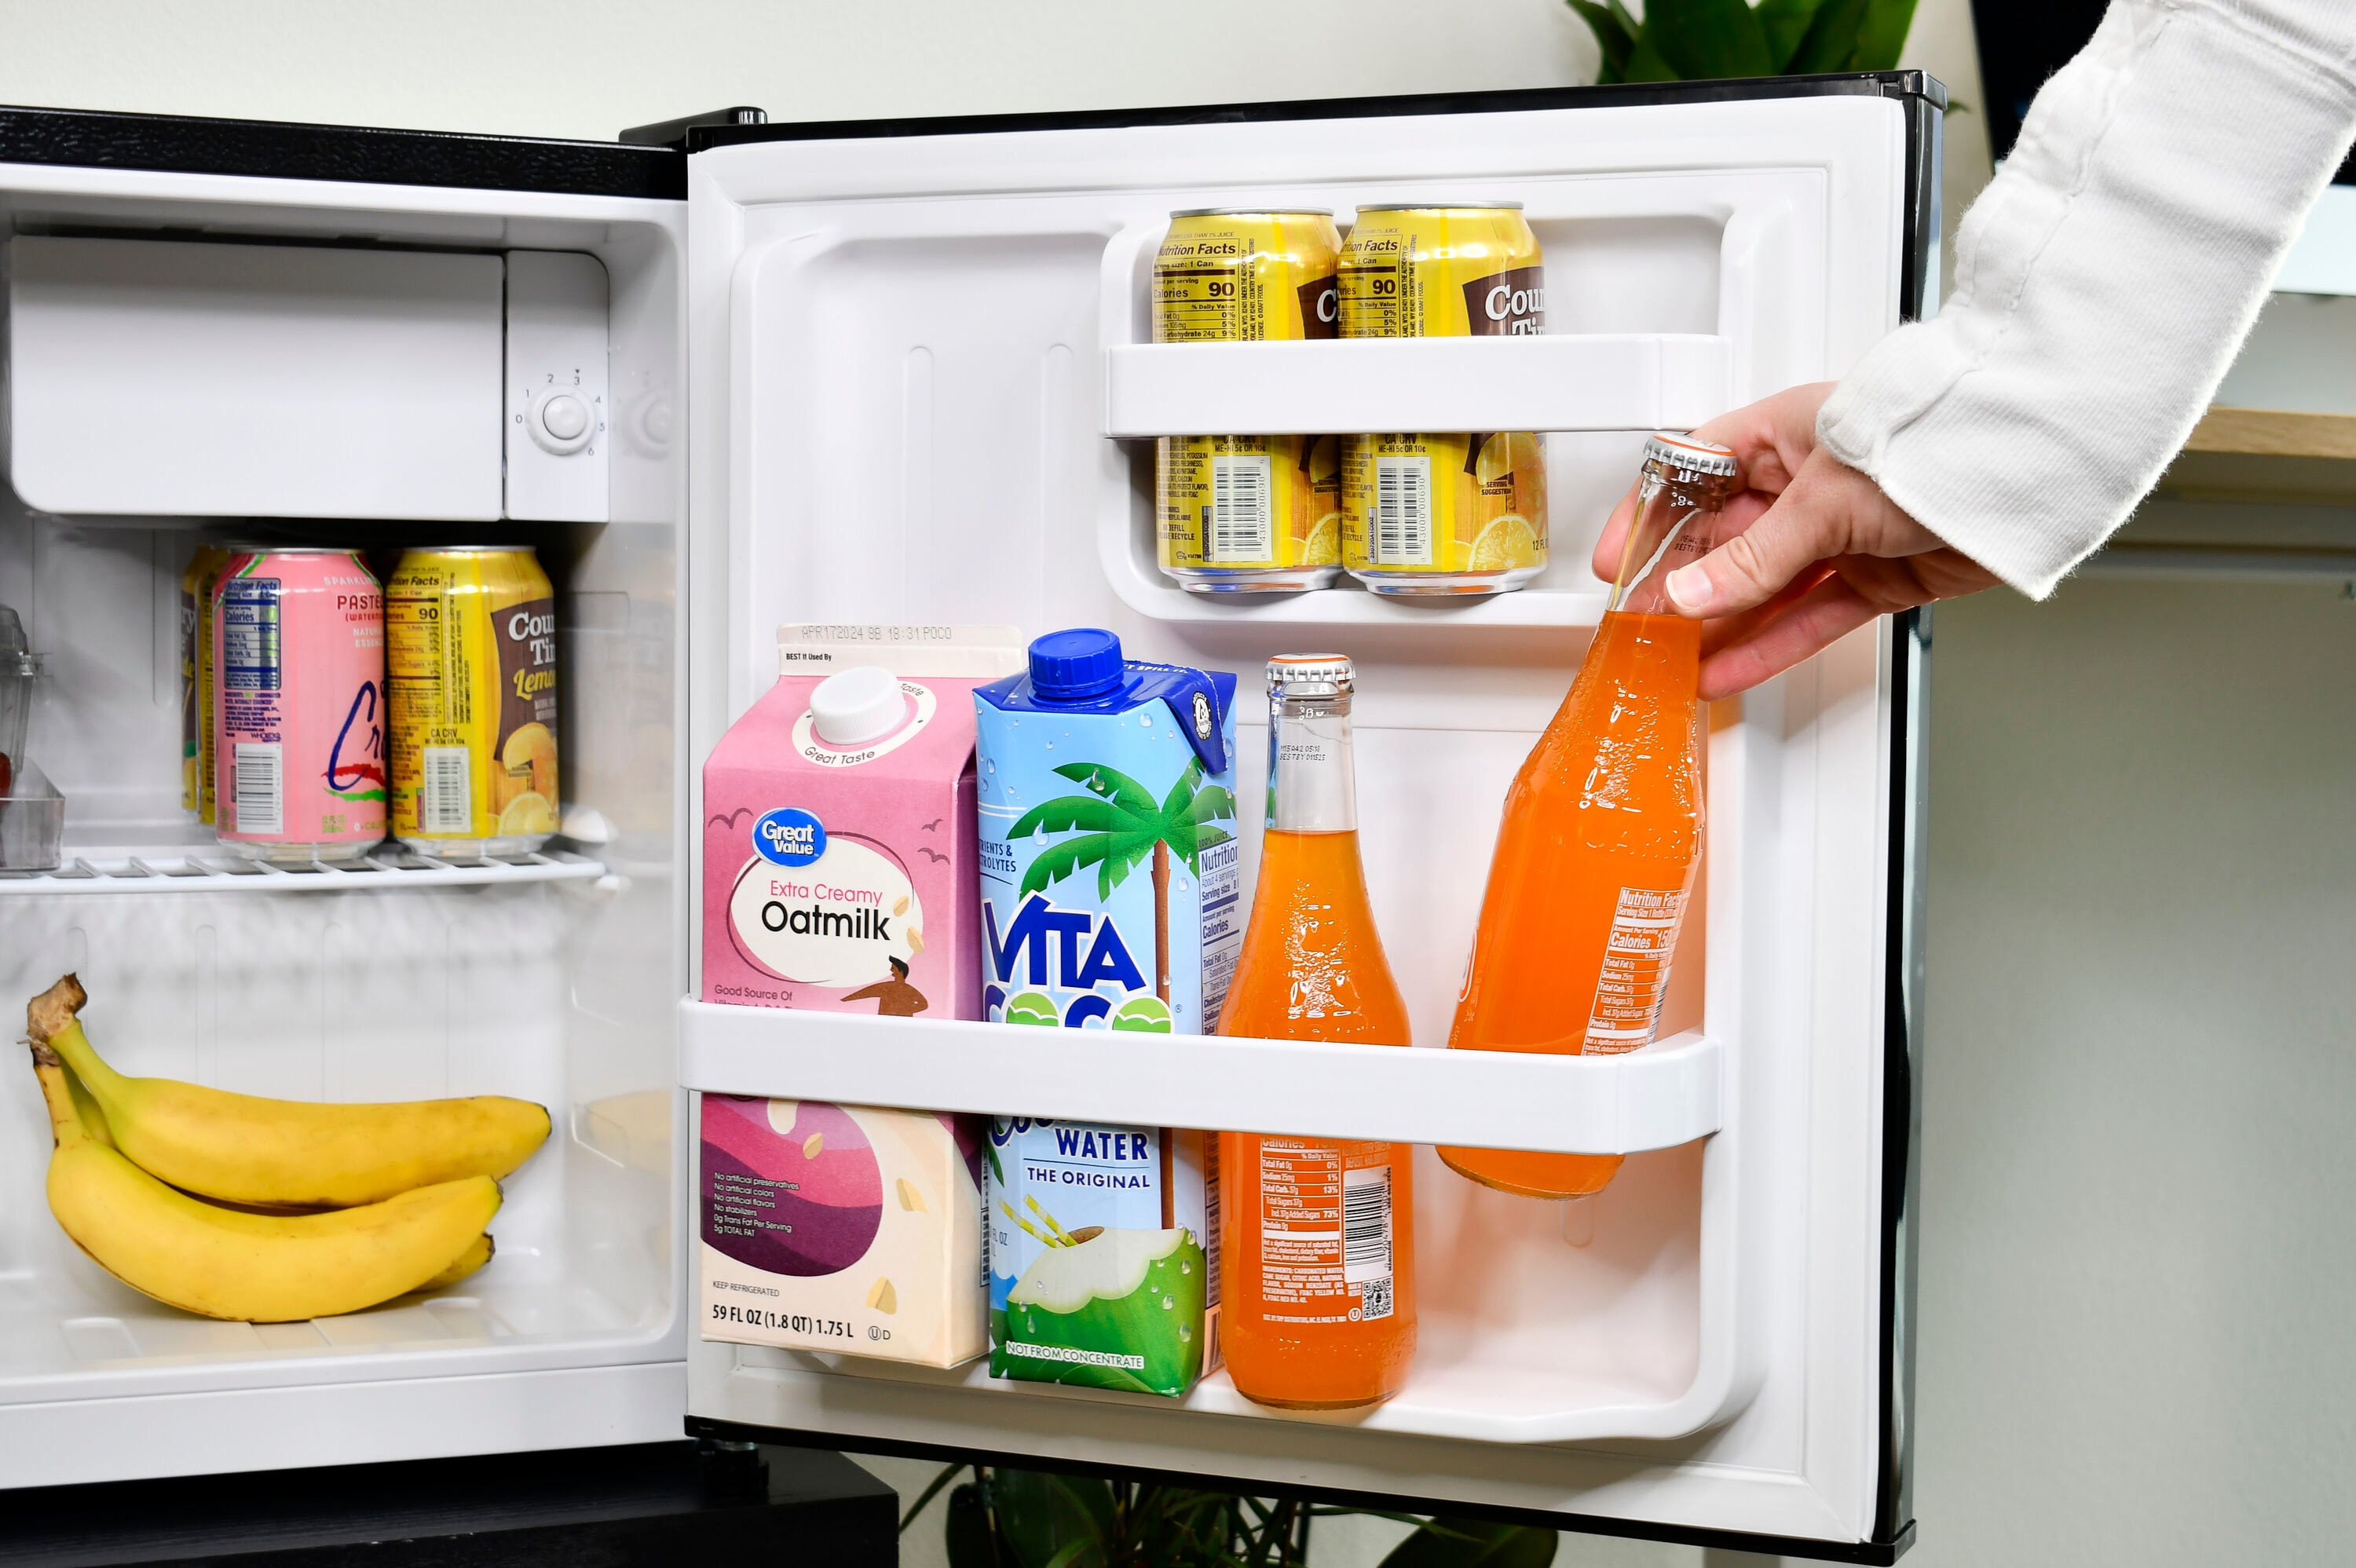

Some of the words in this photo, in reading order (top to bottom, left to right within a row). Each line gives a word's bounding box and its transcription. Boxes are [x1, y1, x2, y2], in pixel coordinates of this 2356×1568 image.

[1198, 243, 1236, 254] Facts
[1364, 239, 1398, 251] Facts
[1154, 287, 1189, 298] Calories
[1209, 282, 1235, 297] 90
[1372, 279, 1396, 294] 90
[547, 375, 554, 383] 2
[574, 376, 580, 386] 3
[515, 414, 523, 424] 0
[599, 422, 605, 432] 5
[1385, 433, 1396, 444] CA
[1399, 433, 1417, 444] CRV
[588, 448, 594, 456] 6
[1417, 477, 1425, 510] 00690
[1532, 540, 1539, 550] 12
[411, 576, 440, 586] Facts
[225, 610, 254, 622] Calories
[419, 608, 439, 620] 90
[353, 627, 383, 637] NATUR
[824, 653, 832, 662] By
[430, 728, 441, 738] CA
[442, 728, 458, 738] CRV
[804, 747, 838, 766] Great
[840, 750, 876, 765] Taste
[761, 820, 815, 843] Great
[1198, 838, 1213, 848] 100%
[1213, 830, 1228, 842] JUICE
[774, 839, 814, 856] Value
[1006, 844, 1013, 857] &
[770, 879, 809, 899] Extra
[814, 883, 883, 908] Creamy
[1202, 888, 1220, 901] Serving
[1220, 883, 1231, 894] size
[1620, 889, 1663, 907] Nutrition
[1663, 892, 1682, 906] Facts
[1617, 905, 1637, 918] Serving
[1637, 908, 1648, 917] Size
[761, 901, 891, 941] Oatmilk
[1202, 919, 1229, 940] Calories
[982, 891, 1149, 992] VITA
[1610, 931, 1652, 949] Calories
[1656, 929, 1672, 948] 150
[1203, 956, 1214, 968] Total
[1605, 959, 1619, 967] Total
[1601, 970, 1622, 980] Sodium
[714, 984, 742, 996] Good
[744, 987, 778, 1000] Source
[781, 991, 793, 1001] Of
[1599, 982, 1613, 991] Total
[1600, 995, 1612, 1003] Total
[1612, 996, 1626, 1006] Sugars
[1590, 1019, 1609, 1028] Protein
[1055, 1128, 1149, 1161] WATER
[1263, 1139, 1305, 1149] Calories
[1326, 1160, 1338, 1169] 0%
[1027, 1167, 1057, 1183] THE
[1062, 1171, 1151, 1189] ORIGINAL
[1263, 1171, 1282, 1180] Sodium
[725, 1175, 752, 1184] artificial
[753, 1179, 799, 1190] preservatives
[1263, 1183, 1275, 1192] Total
[725, 1185, 752, 1194] artificial
[753, 1189, 775, 1197] colors
[725, 1196, 752, 1204] artificial
[752, 1198, 776, 1208] flavors
[1266, 1196, 1277, 1204] Total
[1277, 1197, 1293, 1207] Sugars
[725, 1206, 758, 1216] stabilizers
[714, 1214, 723, 1223] 0g
[723, 1215, 741, 1225] Trans
[765, 1221, 792, 1234] Serving
[714, 1224, 723, 1234] 5g
[723, 1226, 743, 1236] TOTAL
[744, 1228, 755, 1237] FAT
[998, 1231, 1008, 1246] OZ
[712, 1281, 729, 1290] KEEP
[730, 1282, 780, 1297] REFRIGERATED
[712, 1304, 727, 1319] 59
[730, 1307, 744, 1323] FL
[746, 1309, 762, 1325] OZ
[764, 1310, 788, 1329] (1.8
[792, 1315, 813, 1335] QT)
[815, 1319, 843, 1336] 1.75
[847, 1322, 854, 1338] L
[883, 1330, 891, 1340] D
[1007, 1343, 1028, 1356] NOT
[1030, 1347, 1061, 1358] FROM
[1063, 1350, 1143, 1368] CONCENTRATE
